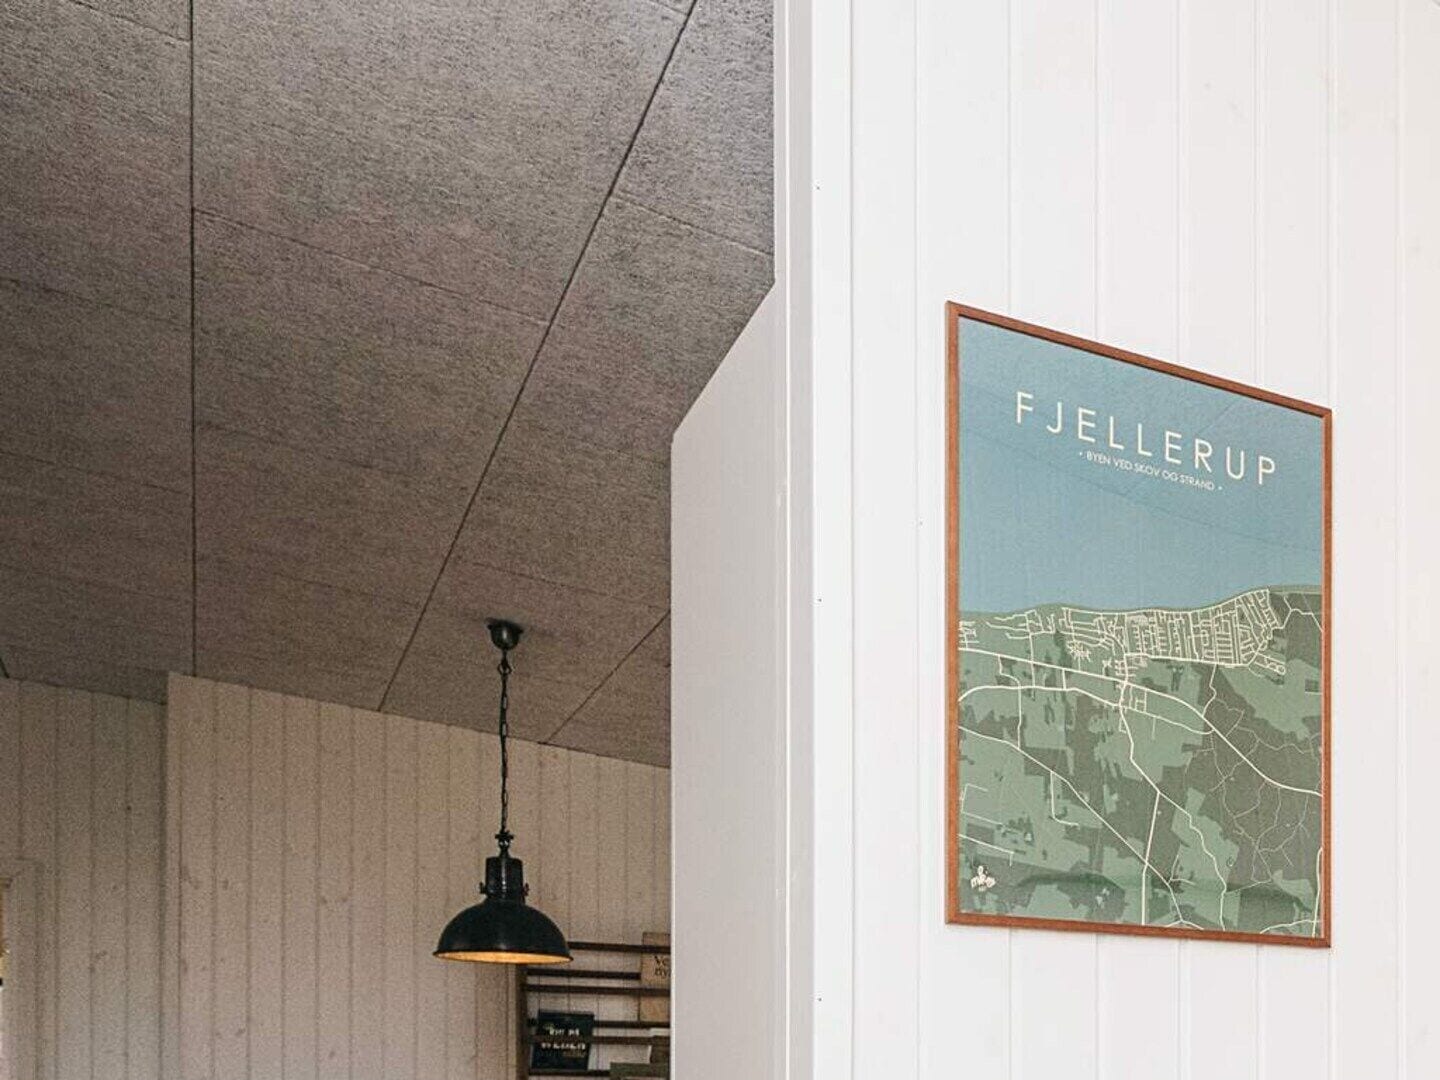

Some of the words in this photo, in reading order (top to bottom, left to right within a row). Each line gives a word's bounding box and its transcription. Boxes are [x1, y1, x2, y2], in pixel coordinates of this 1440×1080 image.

[1016, 391, 1276, 485] FJELLERUP
[1086, 450, 1111, 465] BYEN
[1113, 458, 1133, 471] VED
[1134, 462, 1160, 477] SKOV
[1162, 470, 1178, 481] OG
[1179, 474, 1215, 491] STRAND
